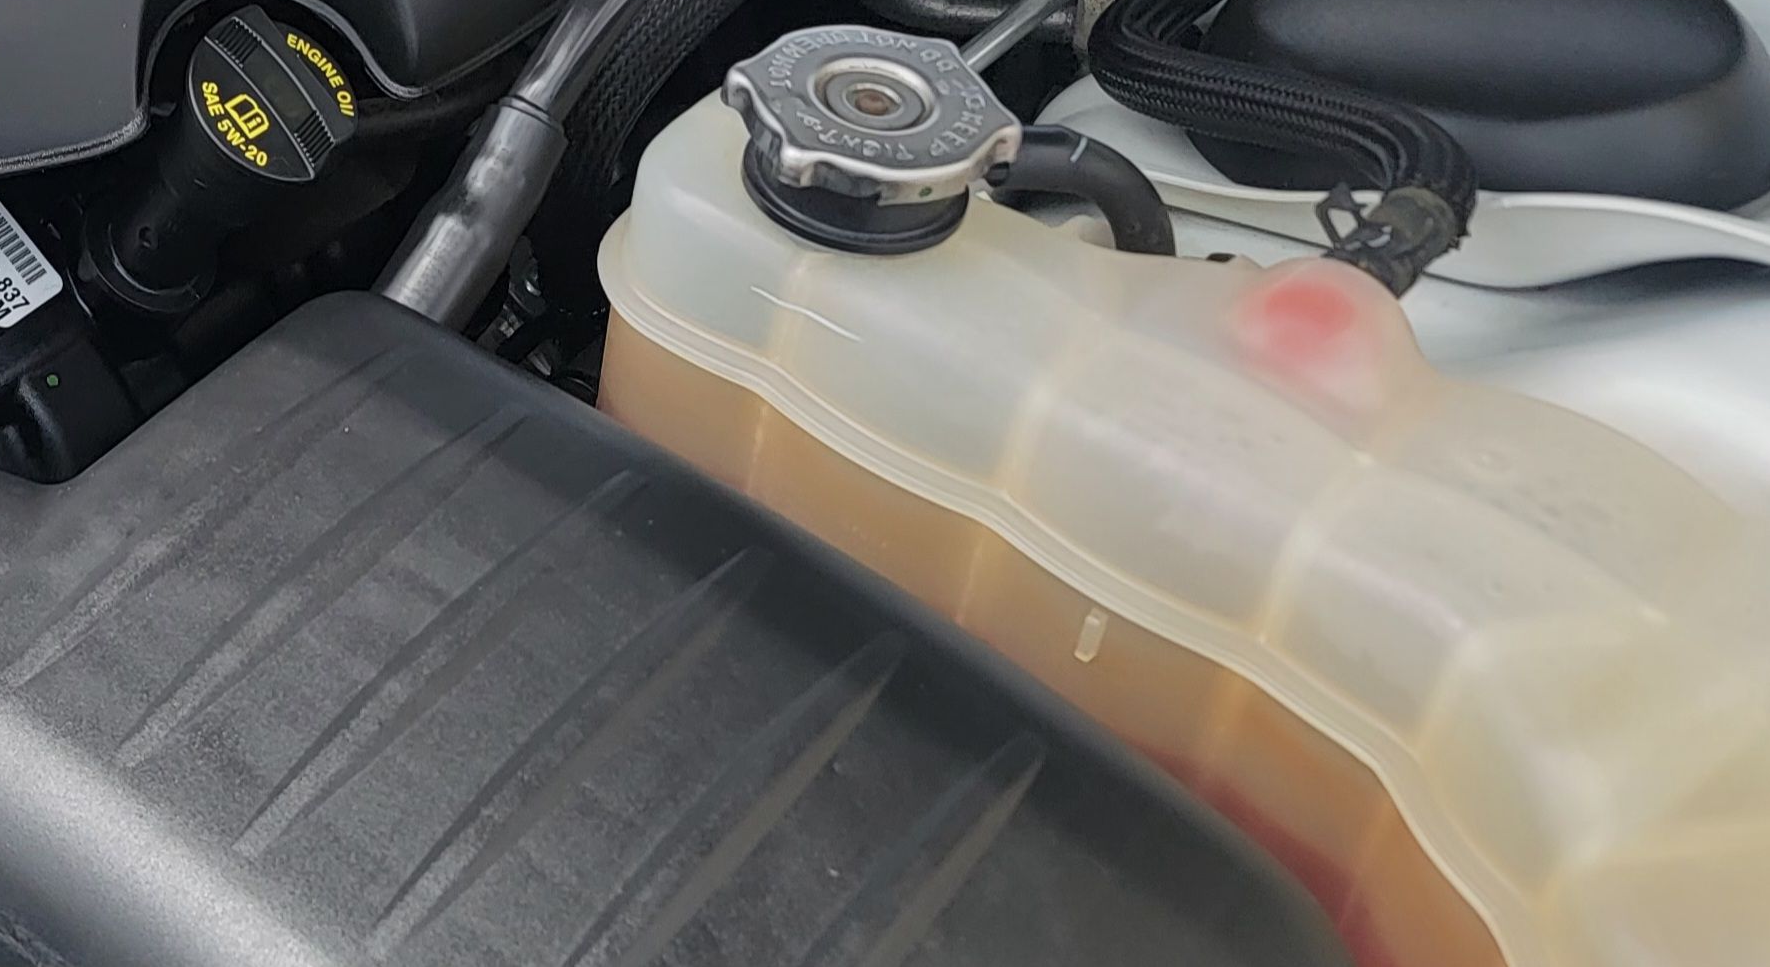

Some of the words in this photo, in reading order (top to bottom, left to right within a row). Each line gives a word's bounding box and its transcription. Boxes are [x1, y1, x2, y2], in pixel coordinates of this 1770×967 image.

[287, 33, 344, 89] ENGINE
[201, 81, 224, 118] SAE
[216, 118, 269, 168] 5W-20
